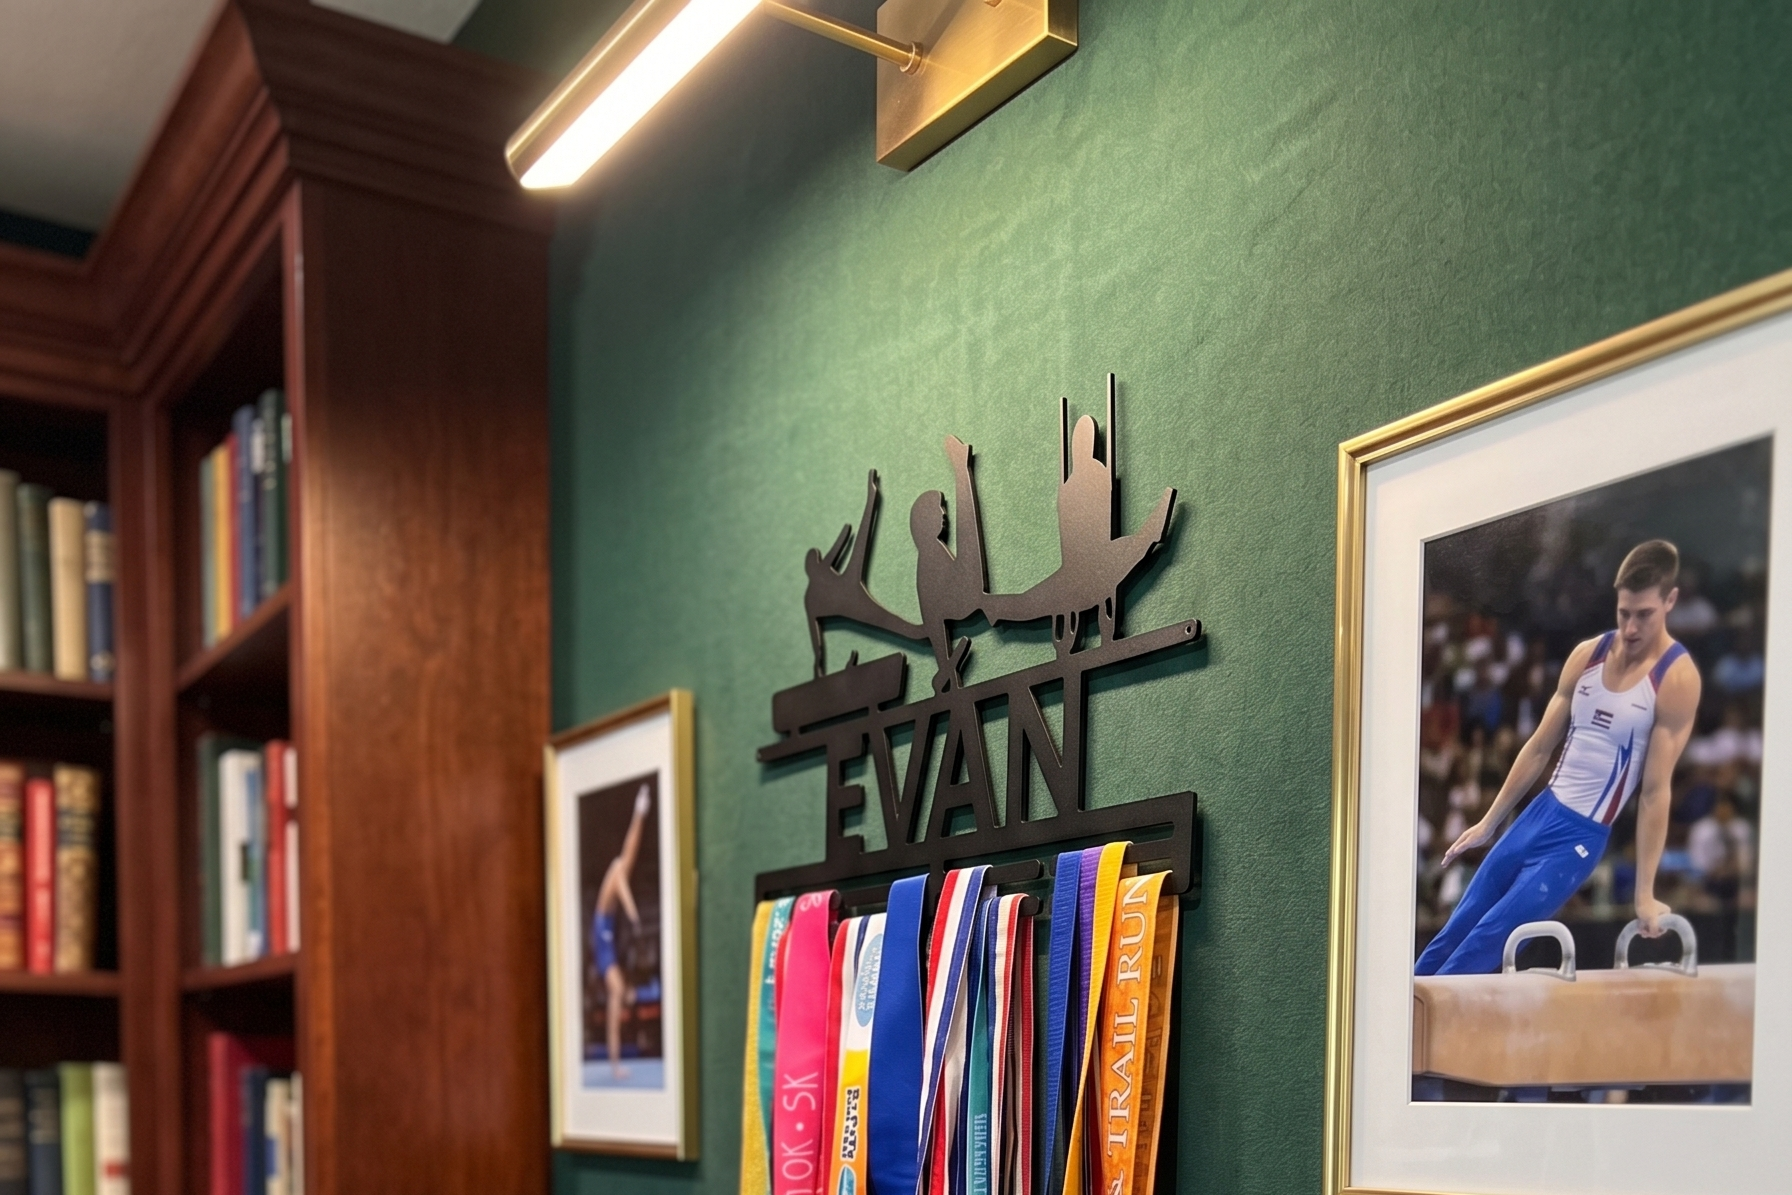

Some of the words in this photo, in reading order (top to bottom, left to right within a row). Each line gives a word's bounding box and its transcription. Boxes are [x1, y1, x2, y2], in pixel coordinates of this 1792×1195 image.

[826, 670, 1085, 860] EVAN
[1116, 874, 1156, 985] RUN
[1106, 998, 1140, 1157] TRAIL
